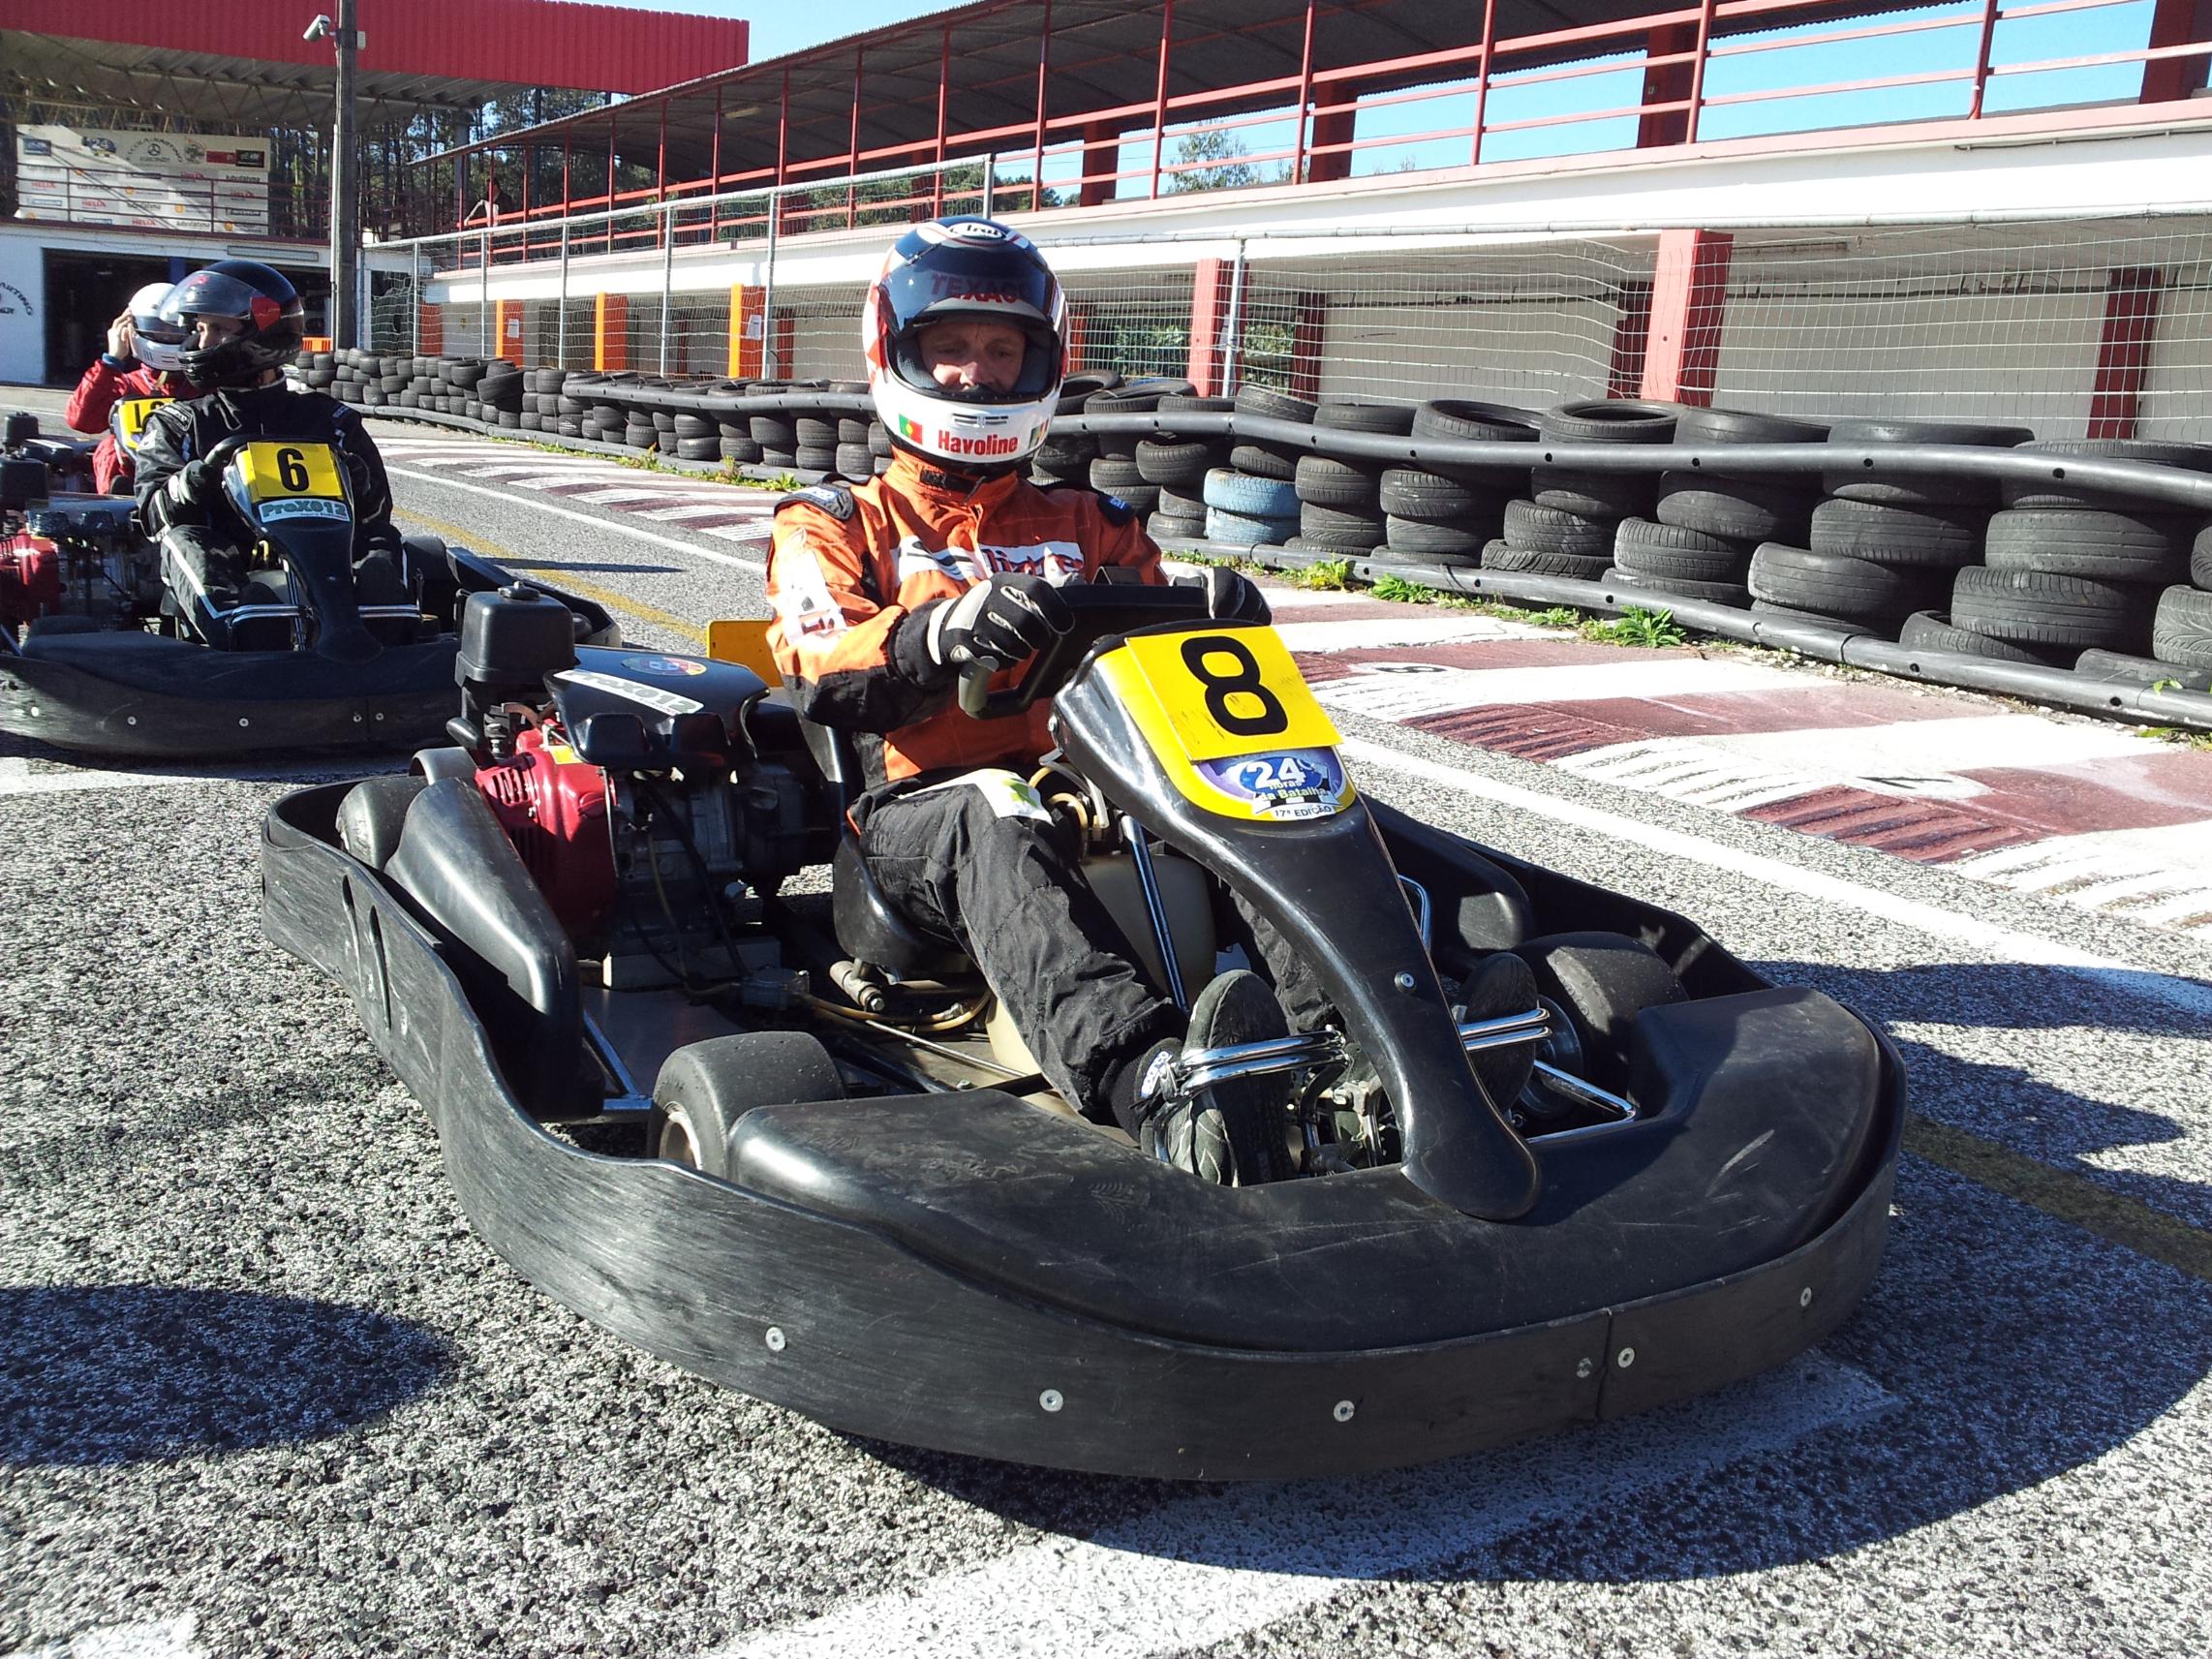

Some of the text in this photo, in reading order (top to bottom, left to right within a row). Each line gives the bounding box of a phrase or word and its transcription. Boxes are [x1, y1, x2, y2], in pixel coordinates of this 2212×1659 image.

[937, 429, 1018, 456] Havoline
[276, 447, 310, 492] 6
[1181, 635, 1289, 736] 8
[1246, 757, 1306, 789] 24
[1261, 786, 1327, 801] da Batalha
[1295, 805, 1333, 817] EDIÇÃO
